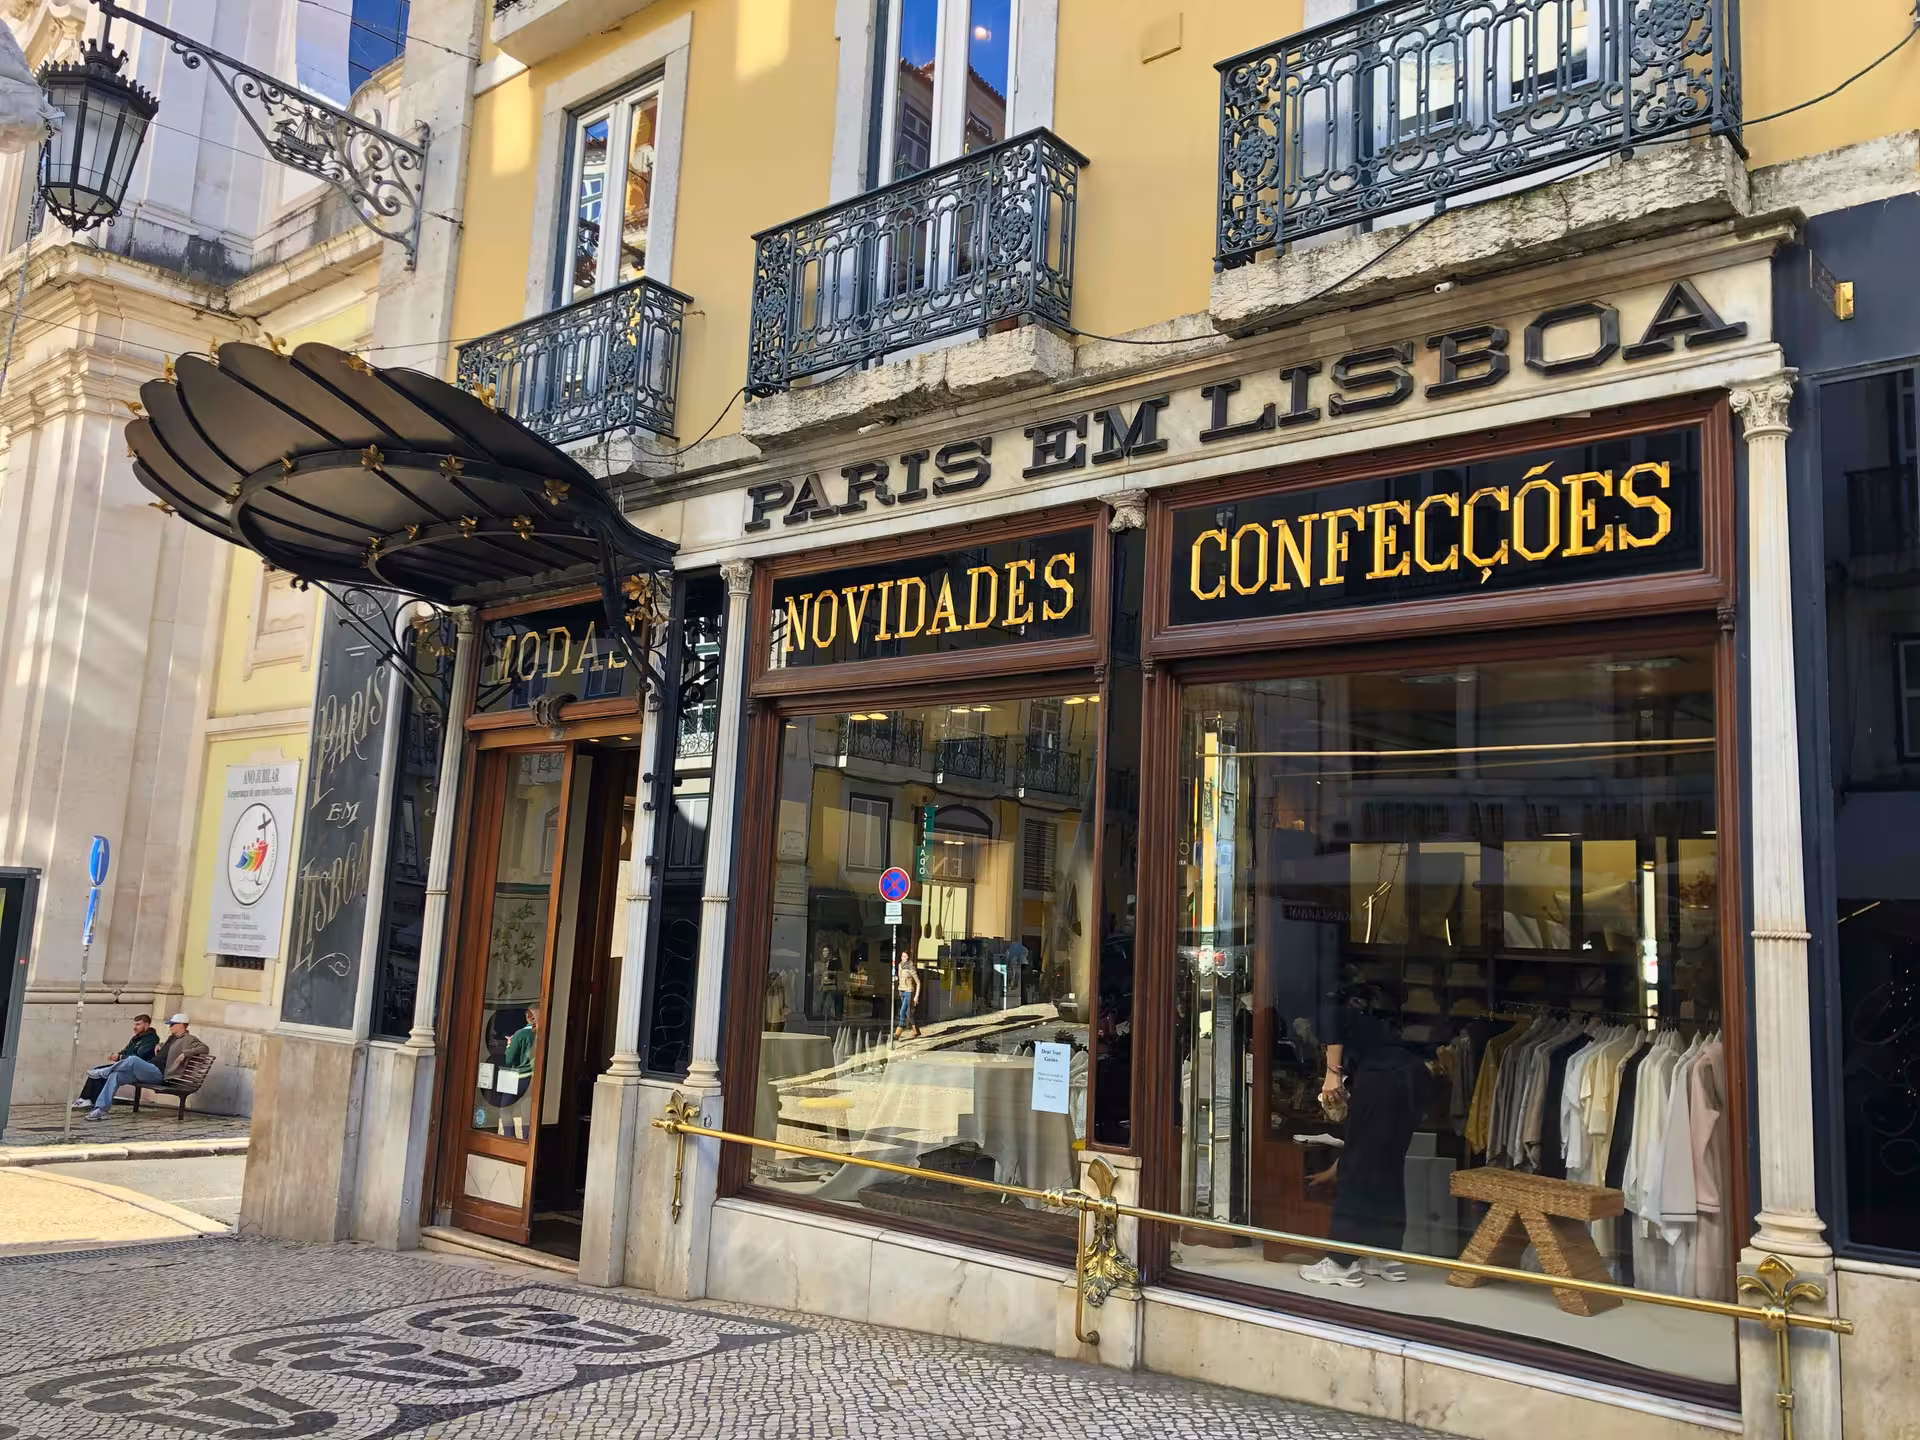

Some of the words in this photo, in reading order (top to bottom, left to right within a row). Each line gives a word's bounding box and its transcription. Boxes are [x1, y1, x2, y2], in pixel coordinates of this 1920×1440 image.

[744, 436, 993, 533] PARIS
[1022, 395, 1170, 479] EM
[1199, 279, 1749, 443] LISBOA
[784, 552, 1076, 653] NOVIDADES
[310, 666, 386, 810] PARIS
[326, 802, 361, 828] EM
[291, 826, 369, 973] LISBOA
